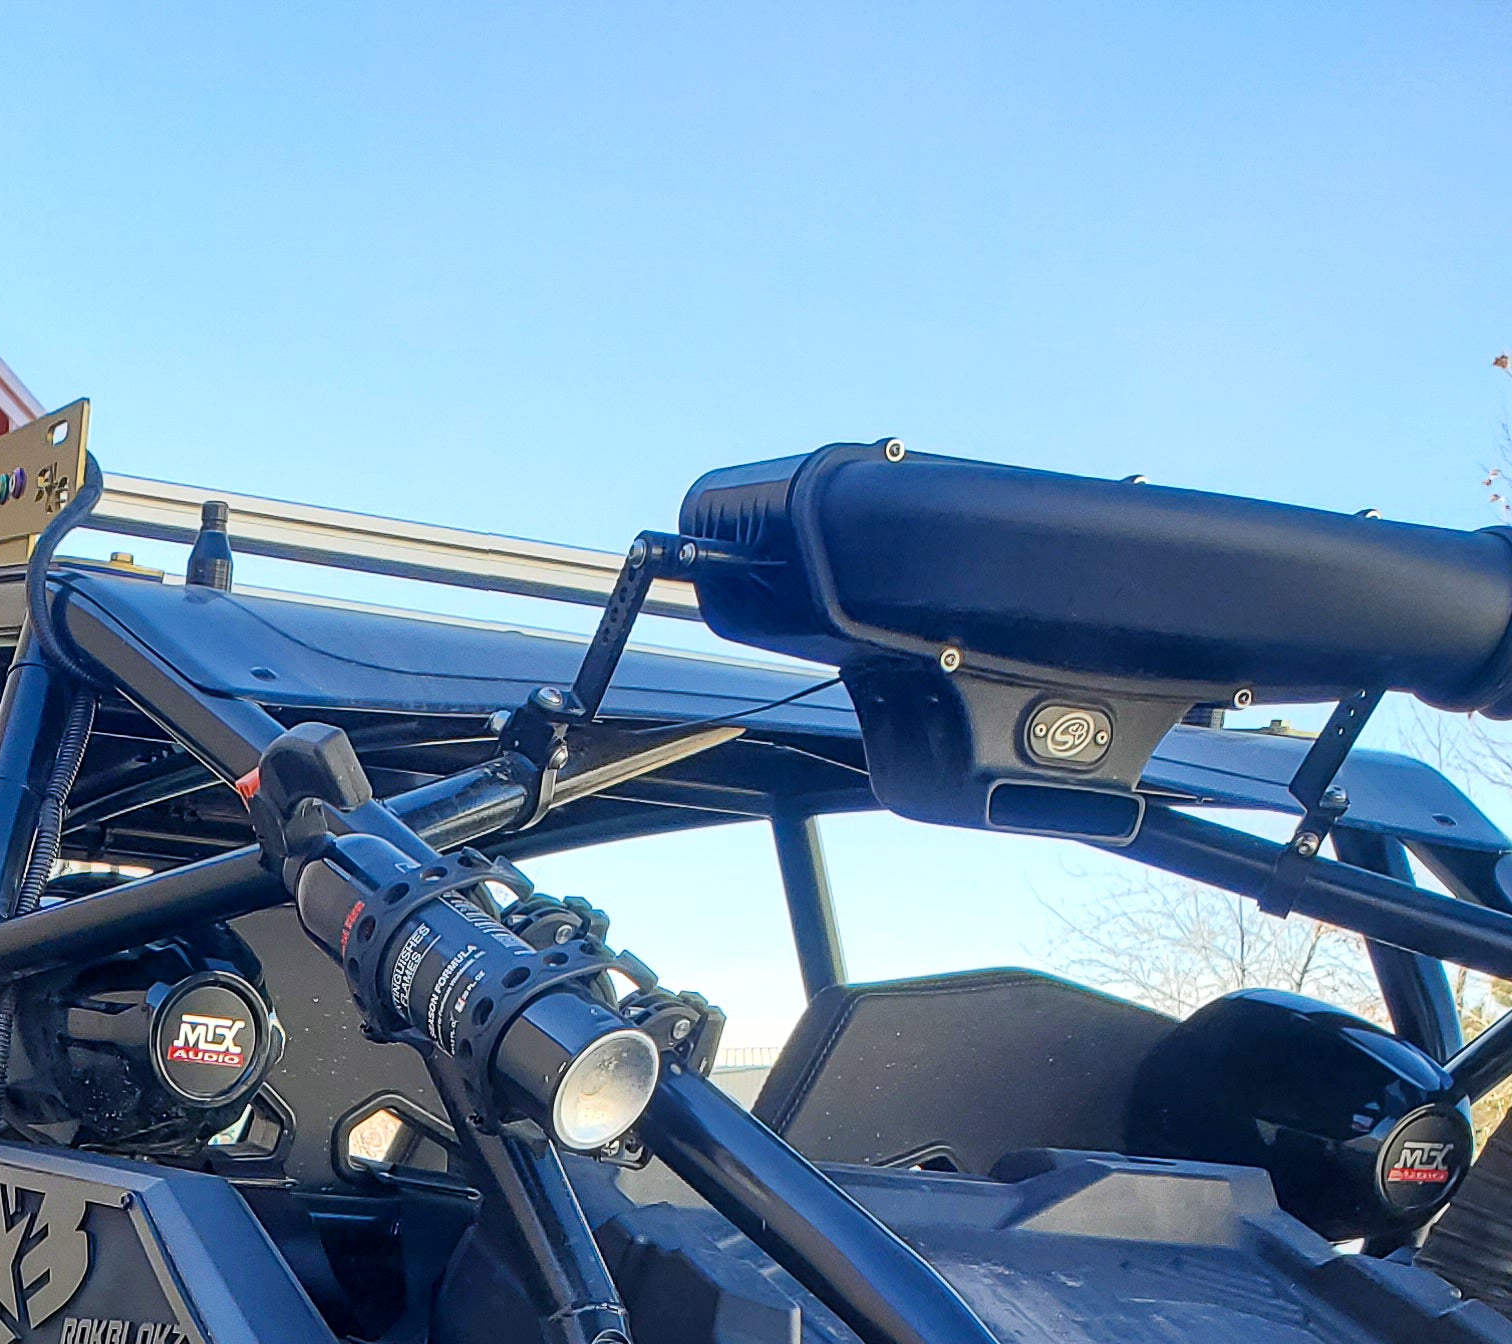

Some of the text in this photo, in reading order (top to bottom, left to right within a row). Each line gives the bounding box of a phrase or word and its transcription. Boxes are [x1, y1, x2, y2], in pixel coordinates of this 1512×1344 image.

[392, 922, 431, 1013] TINGUISHES
[401, 952, 422, 1008] FLAMES
[434, 944, 477, 994] FORMULA
[173, 1014, 246, 1055] MTX
[173, 1049, 240, 1064] AUDIO
[1394, 1141, 1455, 1171] MTX
